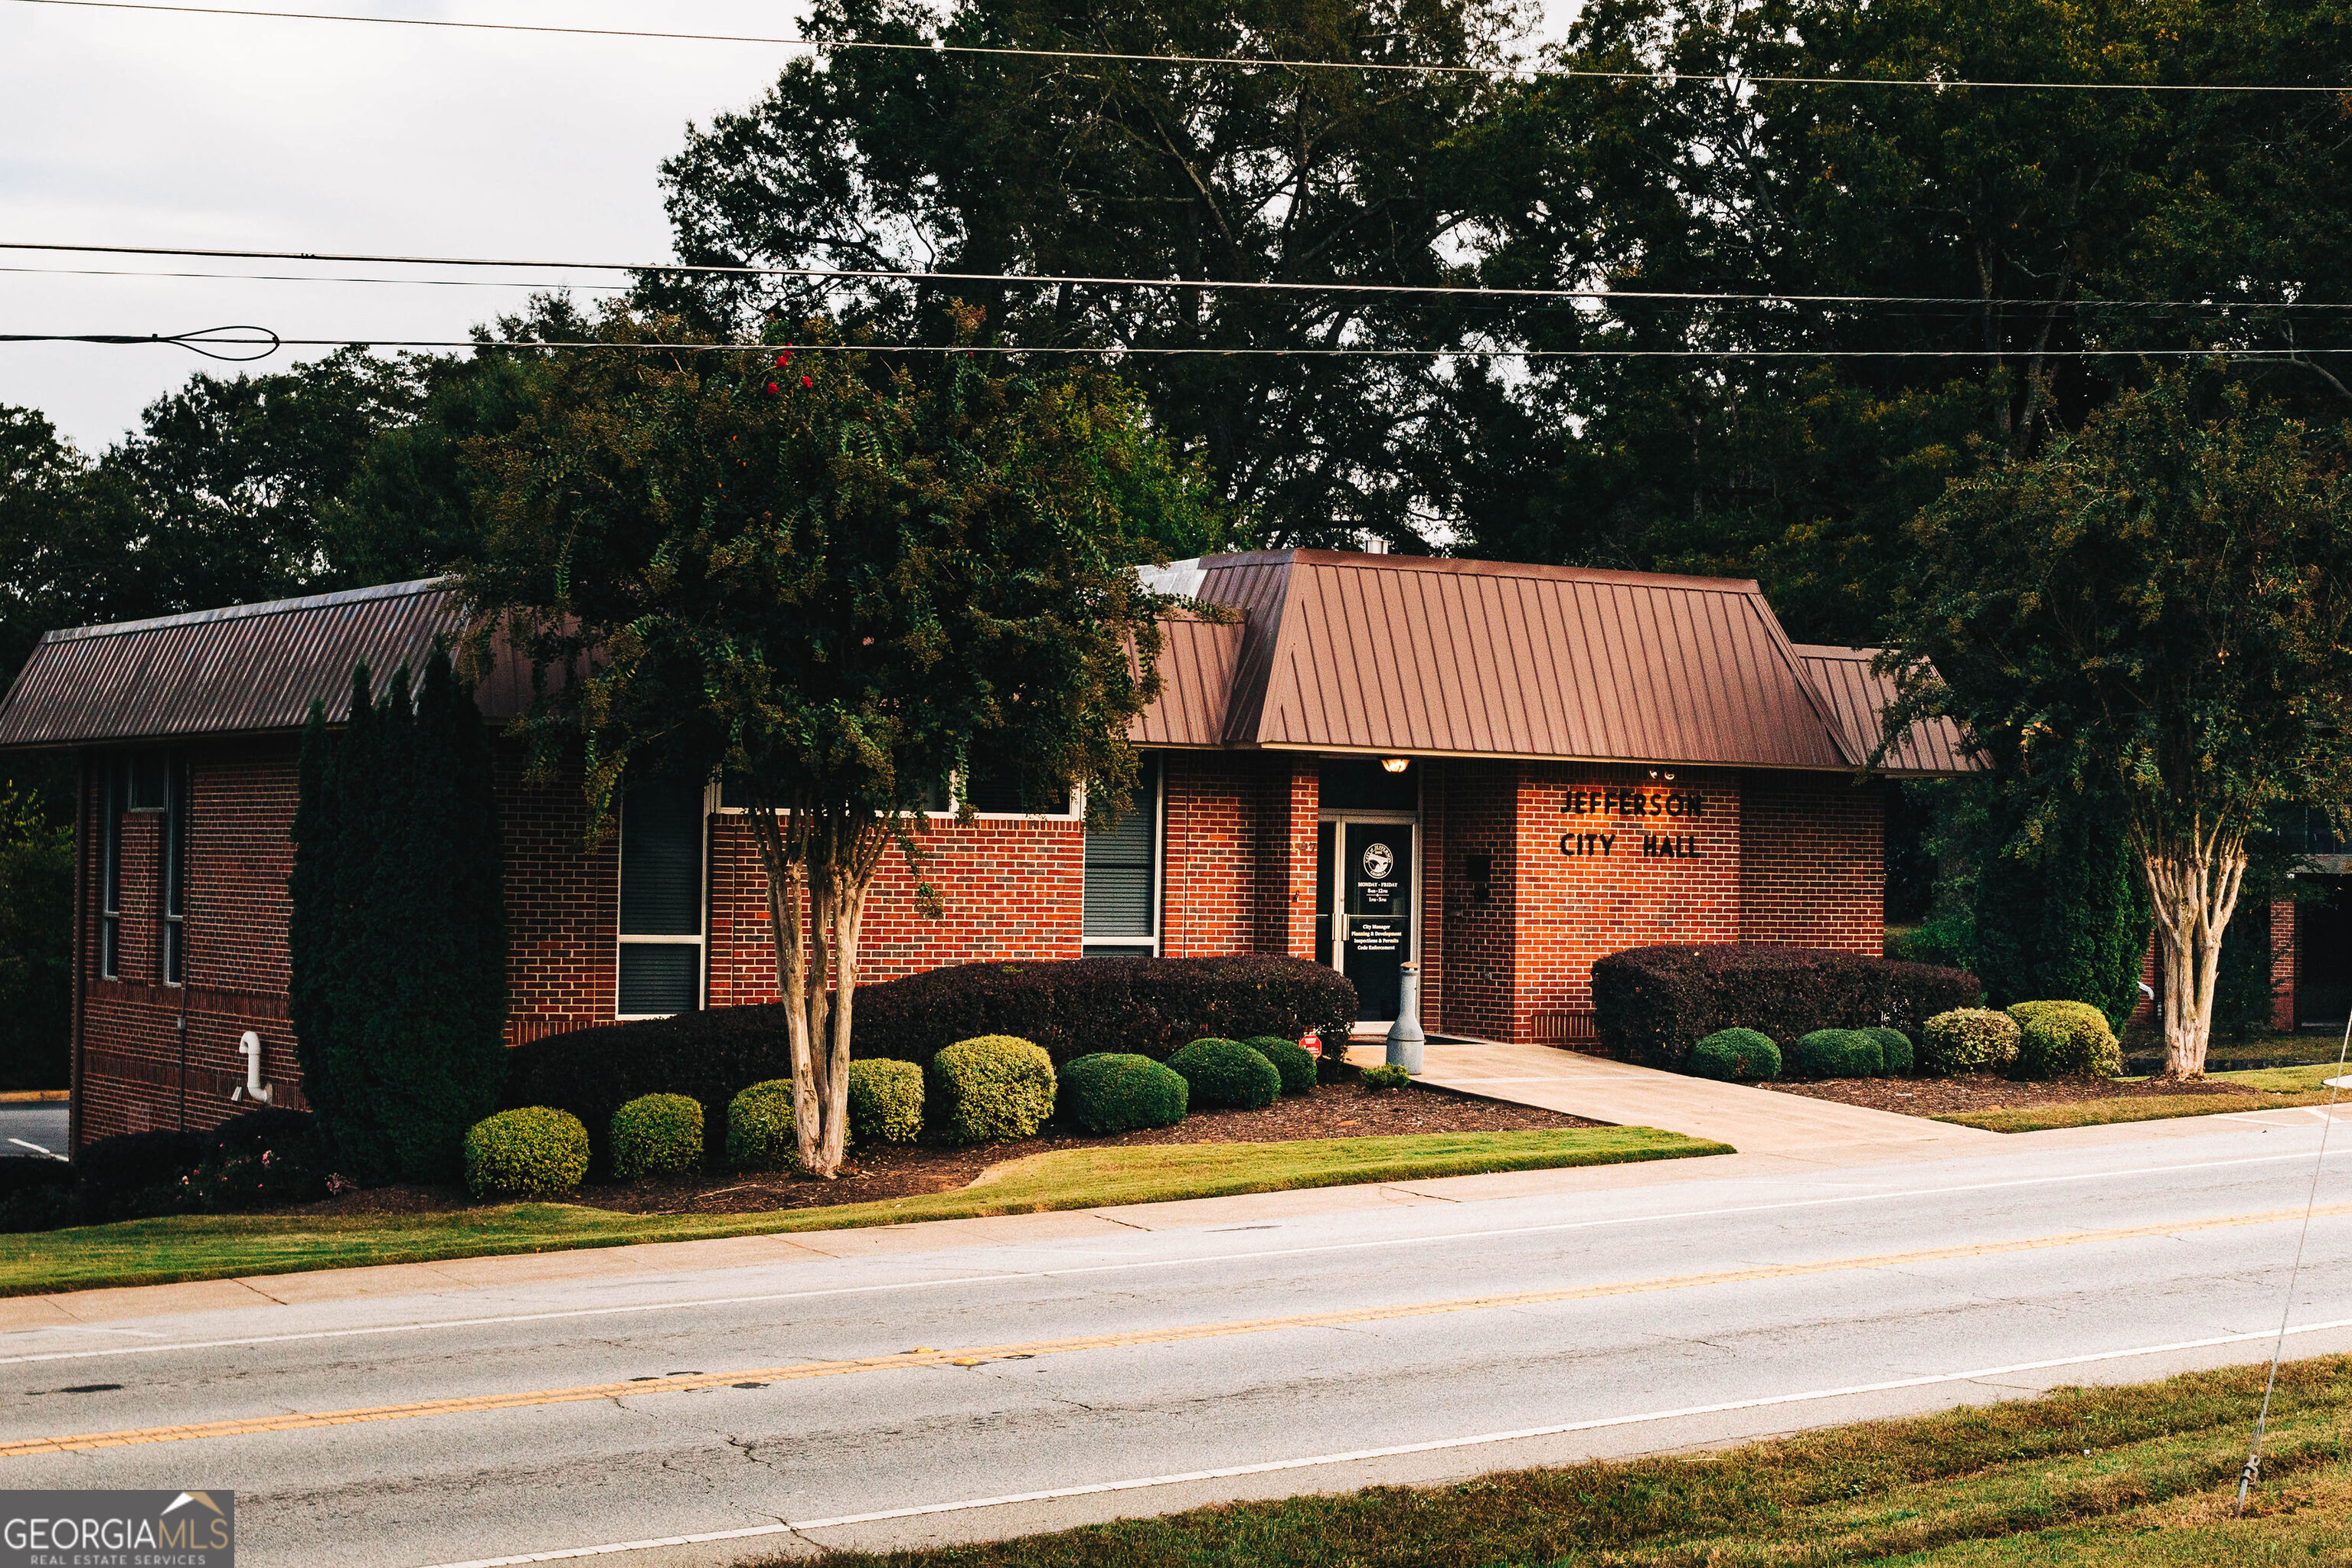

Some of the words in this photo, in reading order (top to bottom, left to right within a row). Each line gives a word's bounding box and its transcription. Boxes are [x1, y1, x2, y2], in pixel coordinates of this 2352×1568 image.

[1560, 791, 1701, 817] JEFFERSON
[1560, 833, 1615, 856] CITY
[1643, 835, 1700, 858] HALL
